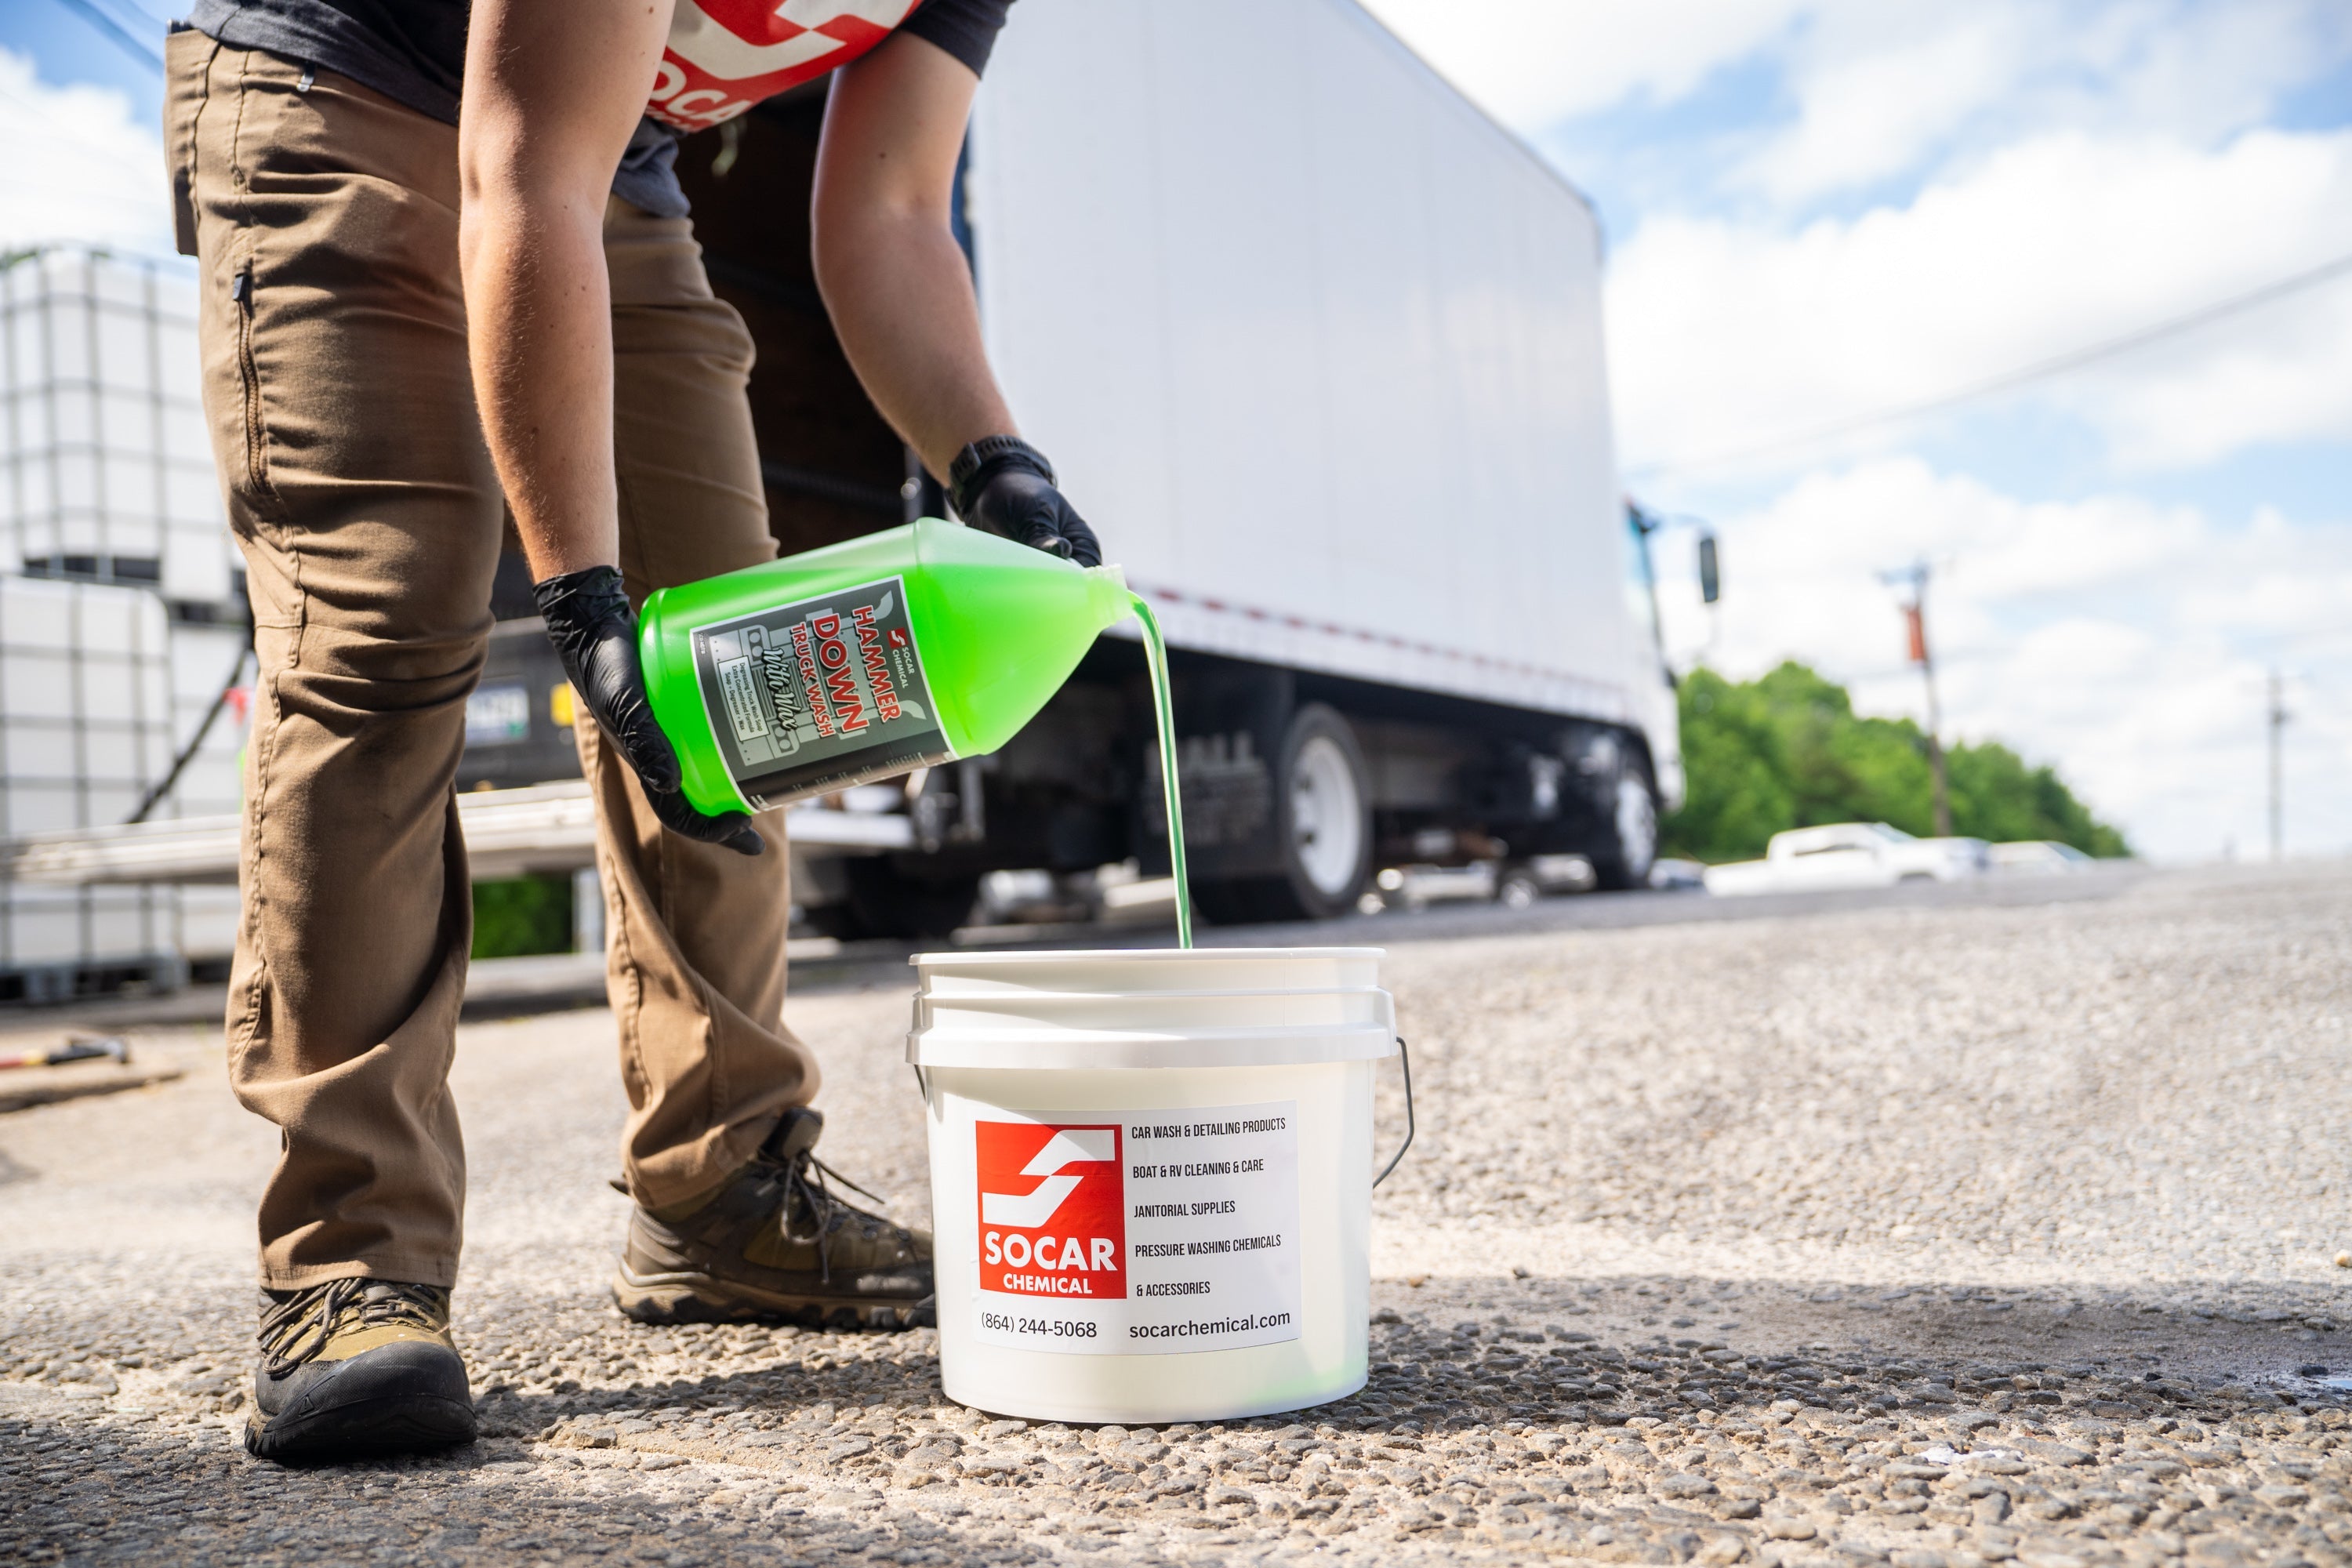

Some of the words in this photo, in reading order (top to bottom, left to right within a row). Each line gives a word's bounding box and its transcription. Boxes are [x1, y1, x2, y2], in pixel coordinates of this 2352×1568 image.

[650, 60, 753, 125] OCA
[763, 648, 789, 691] With
[811, 613, 869, 734] DOWN
[852, 604, 902, 723] HAMMER
[892, 649, 909, 688] CHEMICAL
[902, 647, 915, 674] SOCAR
[739, 662, 750, 691] Degreasing
[790, 622, 818, 682] TRUCK
[805, 683, 837, 738] WASH
[729, 690, 741, 715] Degreaser
[736, 679, 749, 713] Concentrated
[745, 713, 755, 733] Formula
[775, 691, 801, 730] Wax
[1131, 1126, 1151, 1139] CAR
[1153, 1125, 1181, 1138] WASH
[1184, 1124, 1191, 1138] &
[1193, 1122, 1240, 1137] DETAILING
[1243, 1117, 1286, 1134] PRODUCTS
[1133, 1165, 1158, 1178] BOAT
[1160, 1165, 1167, 1178] &
[1170, 1164, 1182, 1177] RV
[1185, 1161, 1231, 1176] CLEANING
[1233, 1160, 1240, 1174] &
[1241, 1159, 1265, 1173] CARE
[1134, 1203, 1189, 1218] JANITORIAL
[1191, 1200, 1236, 1215] SUPPLIES
[985, 1231, 1119, 1272] SOCAR
[1135, 1243, 1185, 1258] PRESSURE
[1187, 1240, 1231, 1255] WASHING
[1233, 1234, 1281, 1252] CHEMICALS
[1003, 1272, 1093, 1295] CHEMICAL
[1136, 1284, 1143, 1297] &
[1145, 1281, 1210, 1297] ACCESSORIES
[981, 1312, 1015, 1333] (864)
[1018, 1318, 1098, 1338] 244-5068
[1130, 1312, 1290, 1338] socarchemical.com
